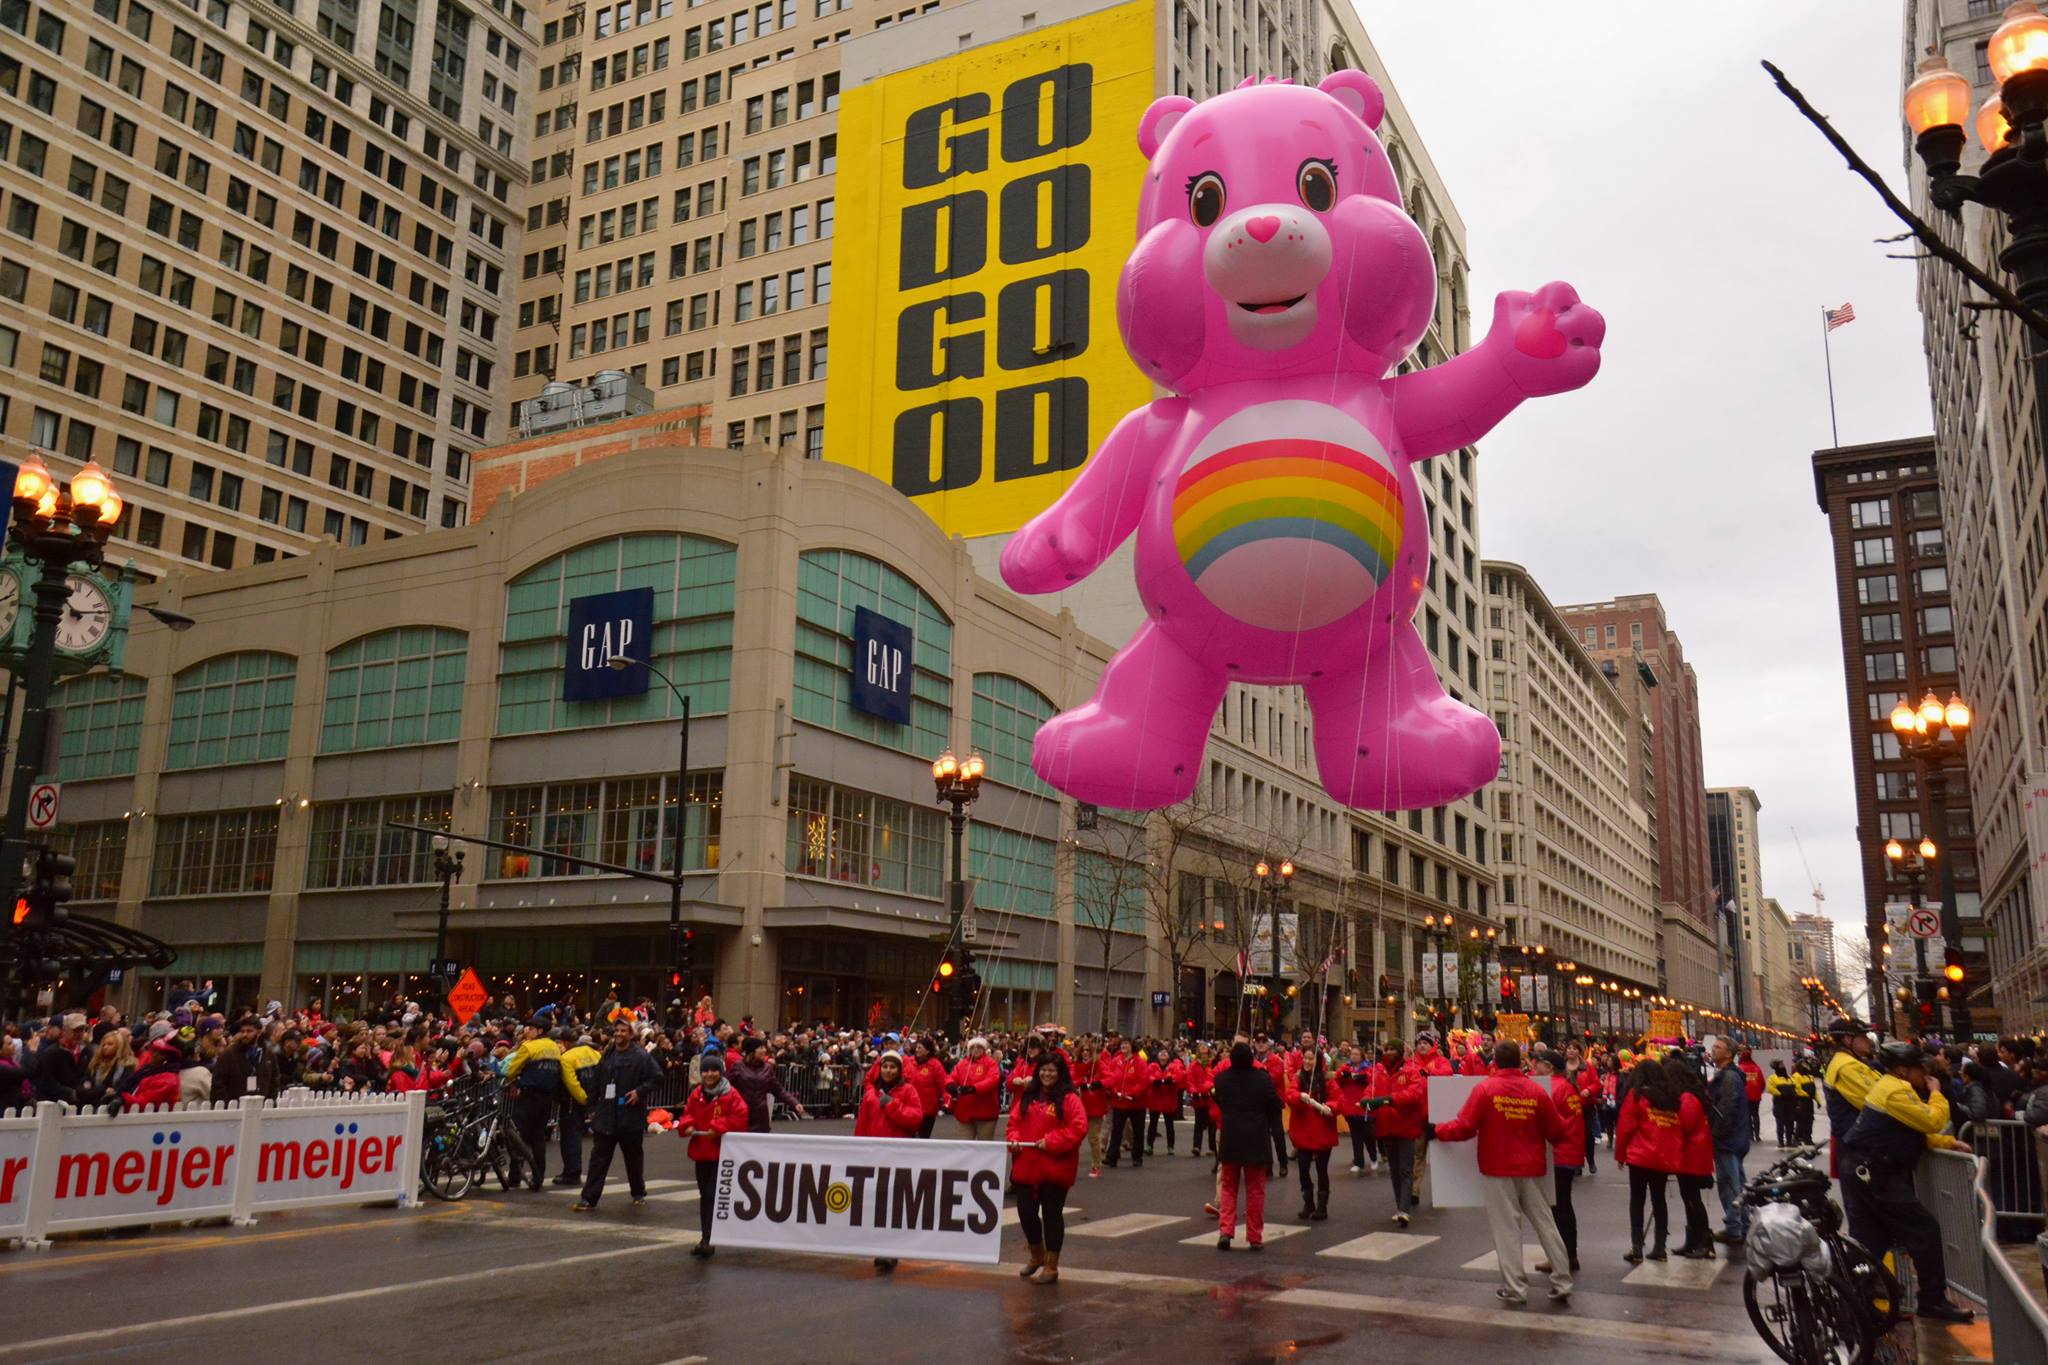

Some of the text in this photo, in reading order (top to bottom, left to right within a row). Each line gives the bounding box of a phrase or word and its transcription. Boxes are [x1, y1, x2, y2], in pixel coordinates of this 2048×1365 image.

[902, 62, 1094, 190] GO
[898, 163, 1092, 293] DO
[895, 267, 1090, 392] GO
[892, 376, 1089, 498] OD
[581, 618, 633, 671] GAP
[867, 638, 902, 694] GAP
[55, 1130, 235, 1206] meijer
[257, 1122, 402, 1189] meijer
[716, 1159, 735, 1220] CHICAGO
